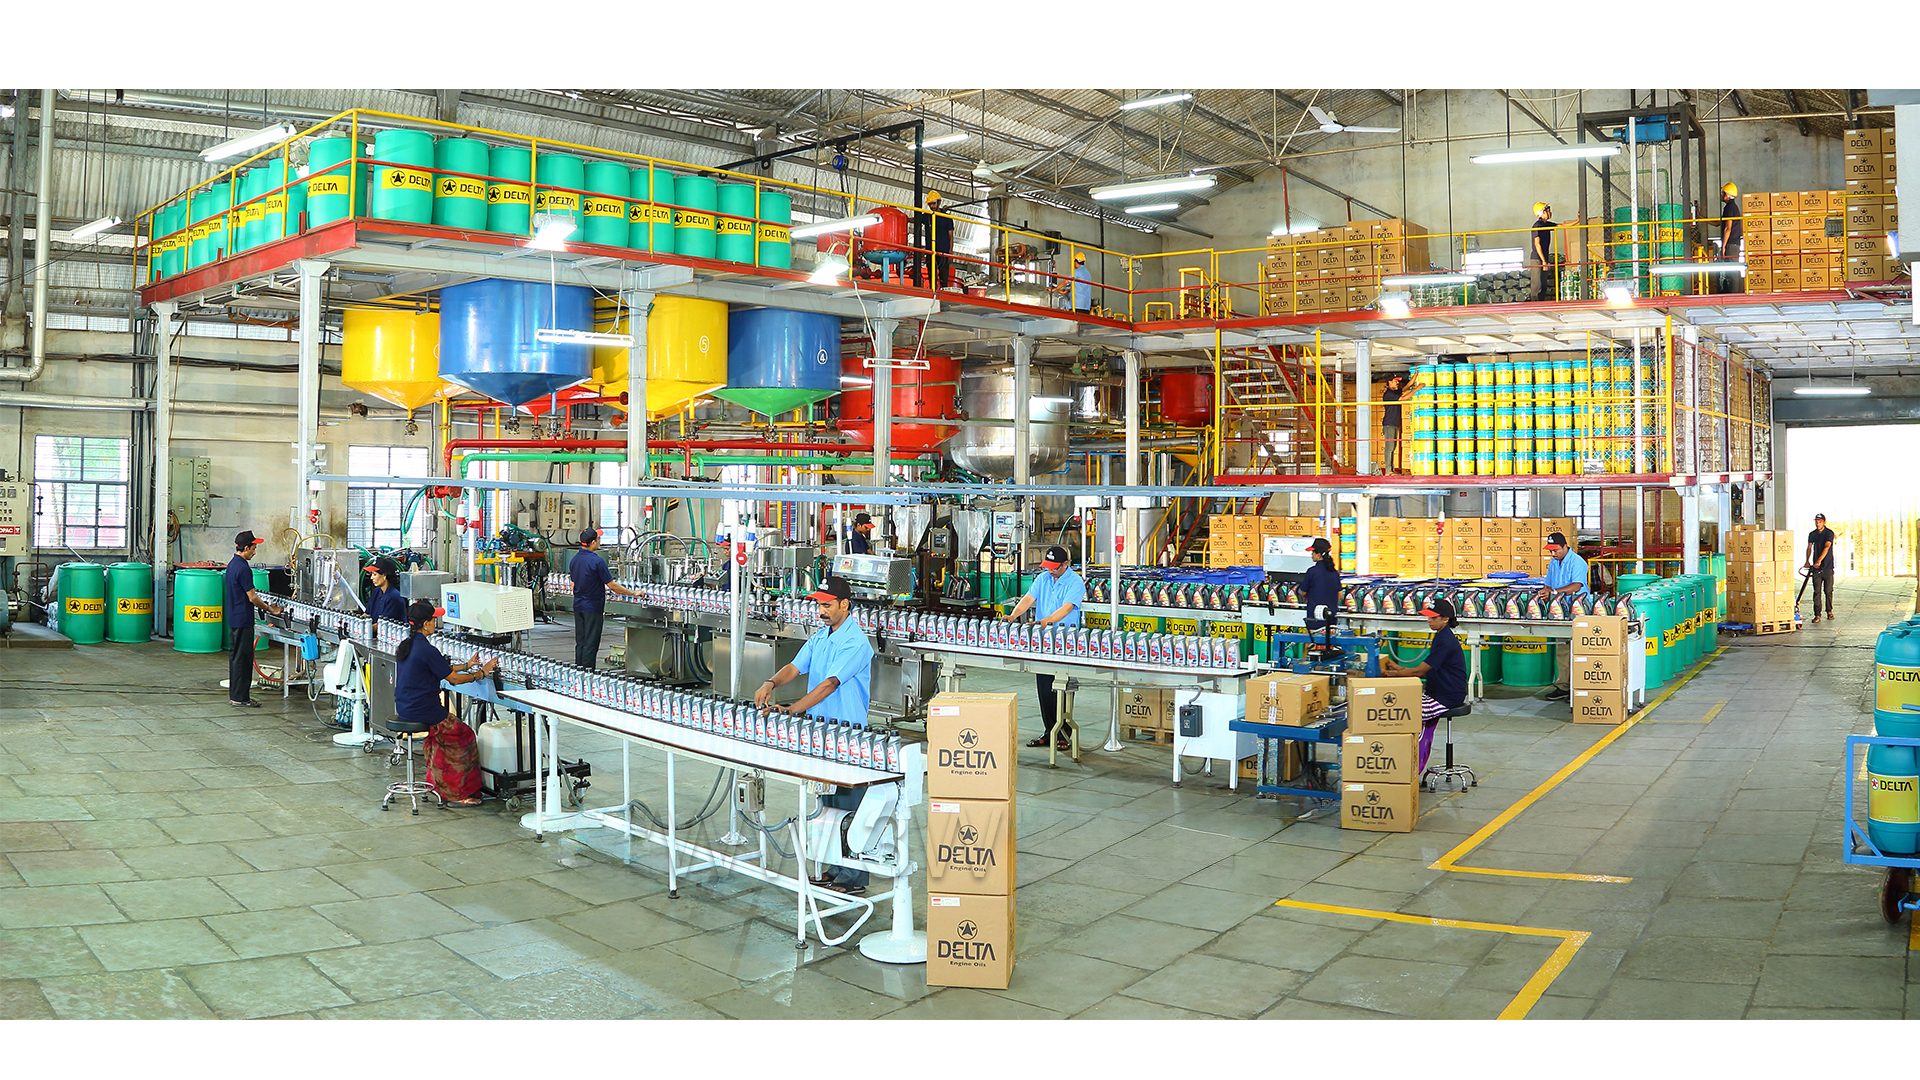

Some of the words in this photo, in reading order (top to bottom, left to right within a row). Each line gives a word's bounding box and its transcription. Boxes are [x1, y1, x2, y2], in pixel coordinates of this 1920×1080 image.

[1850, 139, 1873, 147] DELTA
[1853, 164, 1876, 173] DELTA
[409, 174, 431, 187] DELTA
[312, 182, 338, 192] DELTA
[459, 183, 484, 196] DELTA
[503, 190, 529, 202] DELTA
[596, 203, 622, 214] DELTA
[685, 214, 710, 227] DELTA
[1805, 217, 1823, 225] DELTA
[1852, 215, 1875, 224] DELTA
[727, 220, 752, 232] DELTA
[765, 228, 788, 240] DELTA
[1805, 237, 1823, 245] DELTA
[1854, 241, 1877, 250] DELTA
[1853, 267, 1876, 276] DELTA
[1089, 618, 1111, 626] DELTA
[1129, 621, 1151, 630] DELTA
[1173, 624, 1196, 632] DELTA
[1219, 625, 1244, 633] DELTA
[1581, 636, 1612, 647] DELTA
[1583, 671, 1612, 681] DELTA
[1125, 704, 1152, 716] DELTA
[1367, 708, 1411, 721] DELTA
[1582, 706, 1612, 716] DELTA
[939, 749, 997, 769] DELTA
[1356, 756, 1397, 770] DELTA
[1880, 780, 1913, 792] DELTA
[1351, 805, 1394, 819] DELTA
[938, 844, 996, 866] DELTA
[938, 940, 996, 961] DELTA
